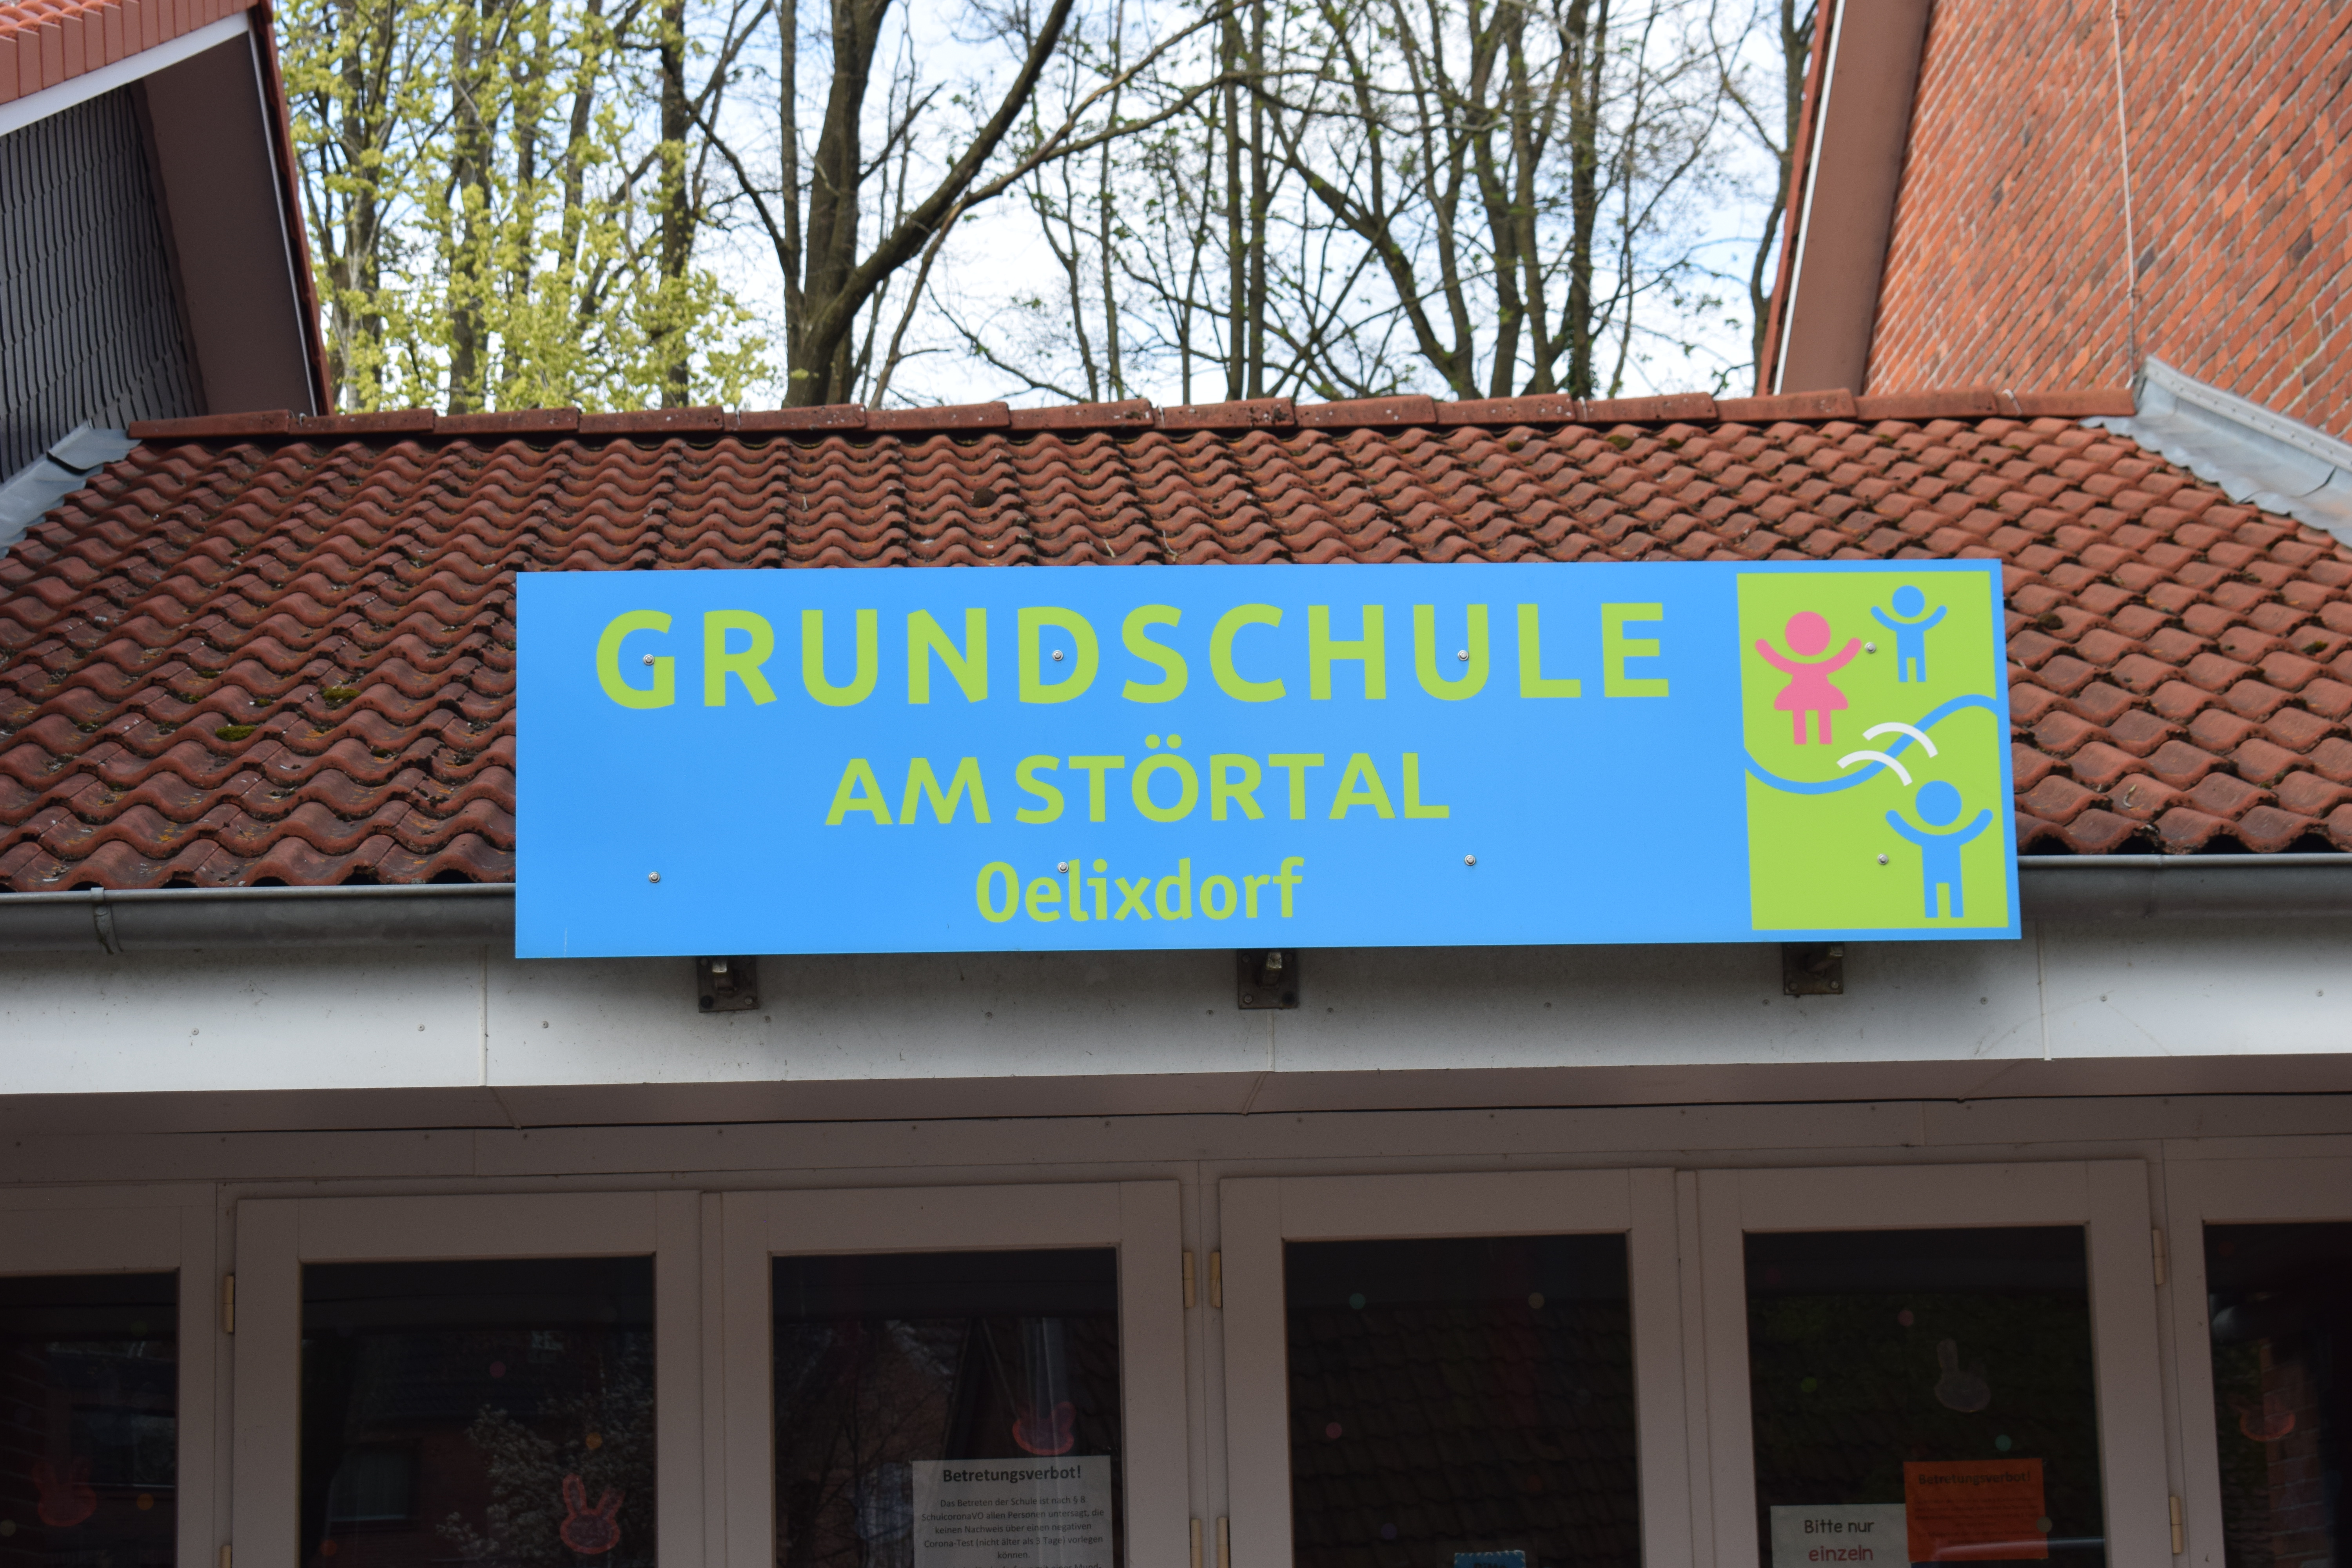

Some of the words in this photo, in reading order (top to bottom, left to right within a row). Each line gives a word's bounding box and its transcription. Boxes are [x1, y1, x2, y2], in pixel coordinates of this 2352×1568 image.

[596, 603, 1669, 709] GRUNDSCHULE
[825, 757, 991, 825] AM
[1015, 734, 1449, 824] STÖRTAL
[976, 856, 1304, 922] Oelixdorf
[943, 1465, 1080, 1483] Betretungsverbot!
[1918, 1470, 2031, 1486] Betretungsverbot!
[1051, 1496, 1071, 1504] nach
[1073, 1495, 1078, 1504] §
[922, 1512, 984, 1521] SchulcoronaVO
[1048, 1509, 1089, 1518] untersagt,
[965, 1525, 1004, 1533] Nachweis
[1052, 1523, 1091, 1532] negativen
[1804, 1519, 1842, 1534] Bitte
[1848, 1521, 1875, 1533] nur
[924, 1539, 974, 1548] Corona-Test
[976, 1538, 999, 1547] (nicht
[1043, 1536, 1065, 1546] Tage)
[1068, 1535, 1103, 1544] vorlegen
[1808, 1545, 1873, 1561] einzeln
